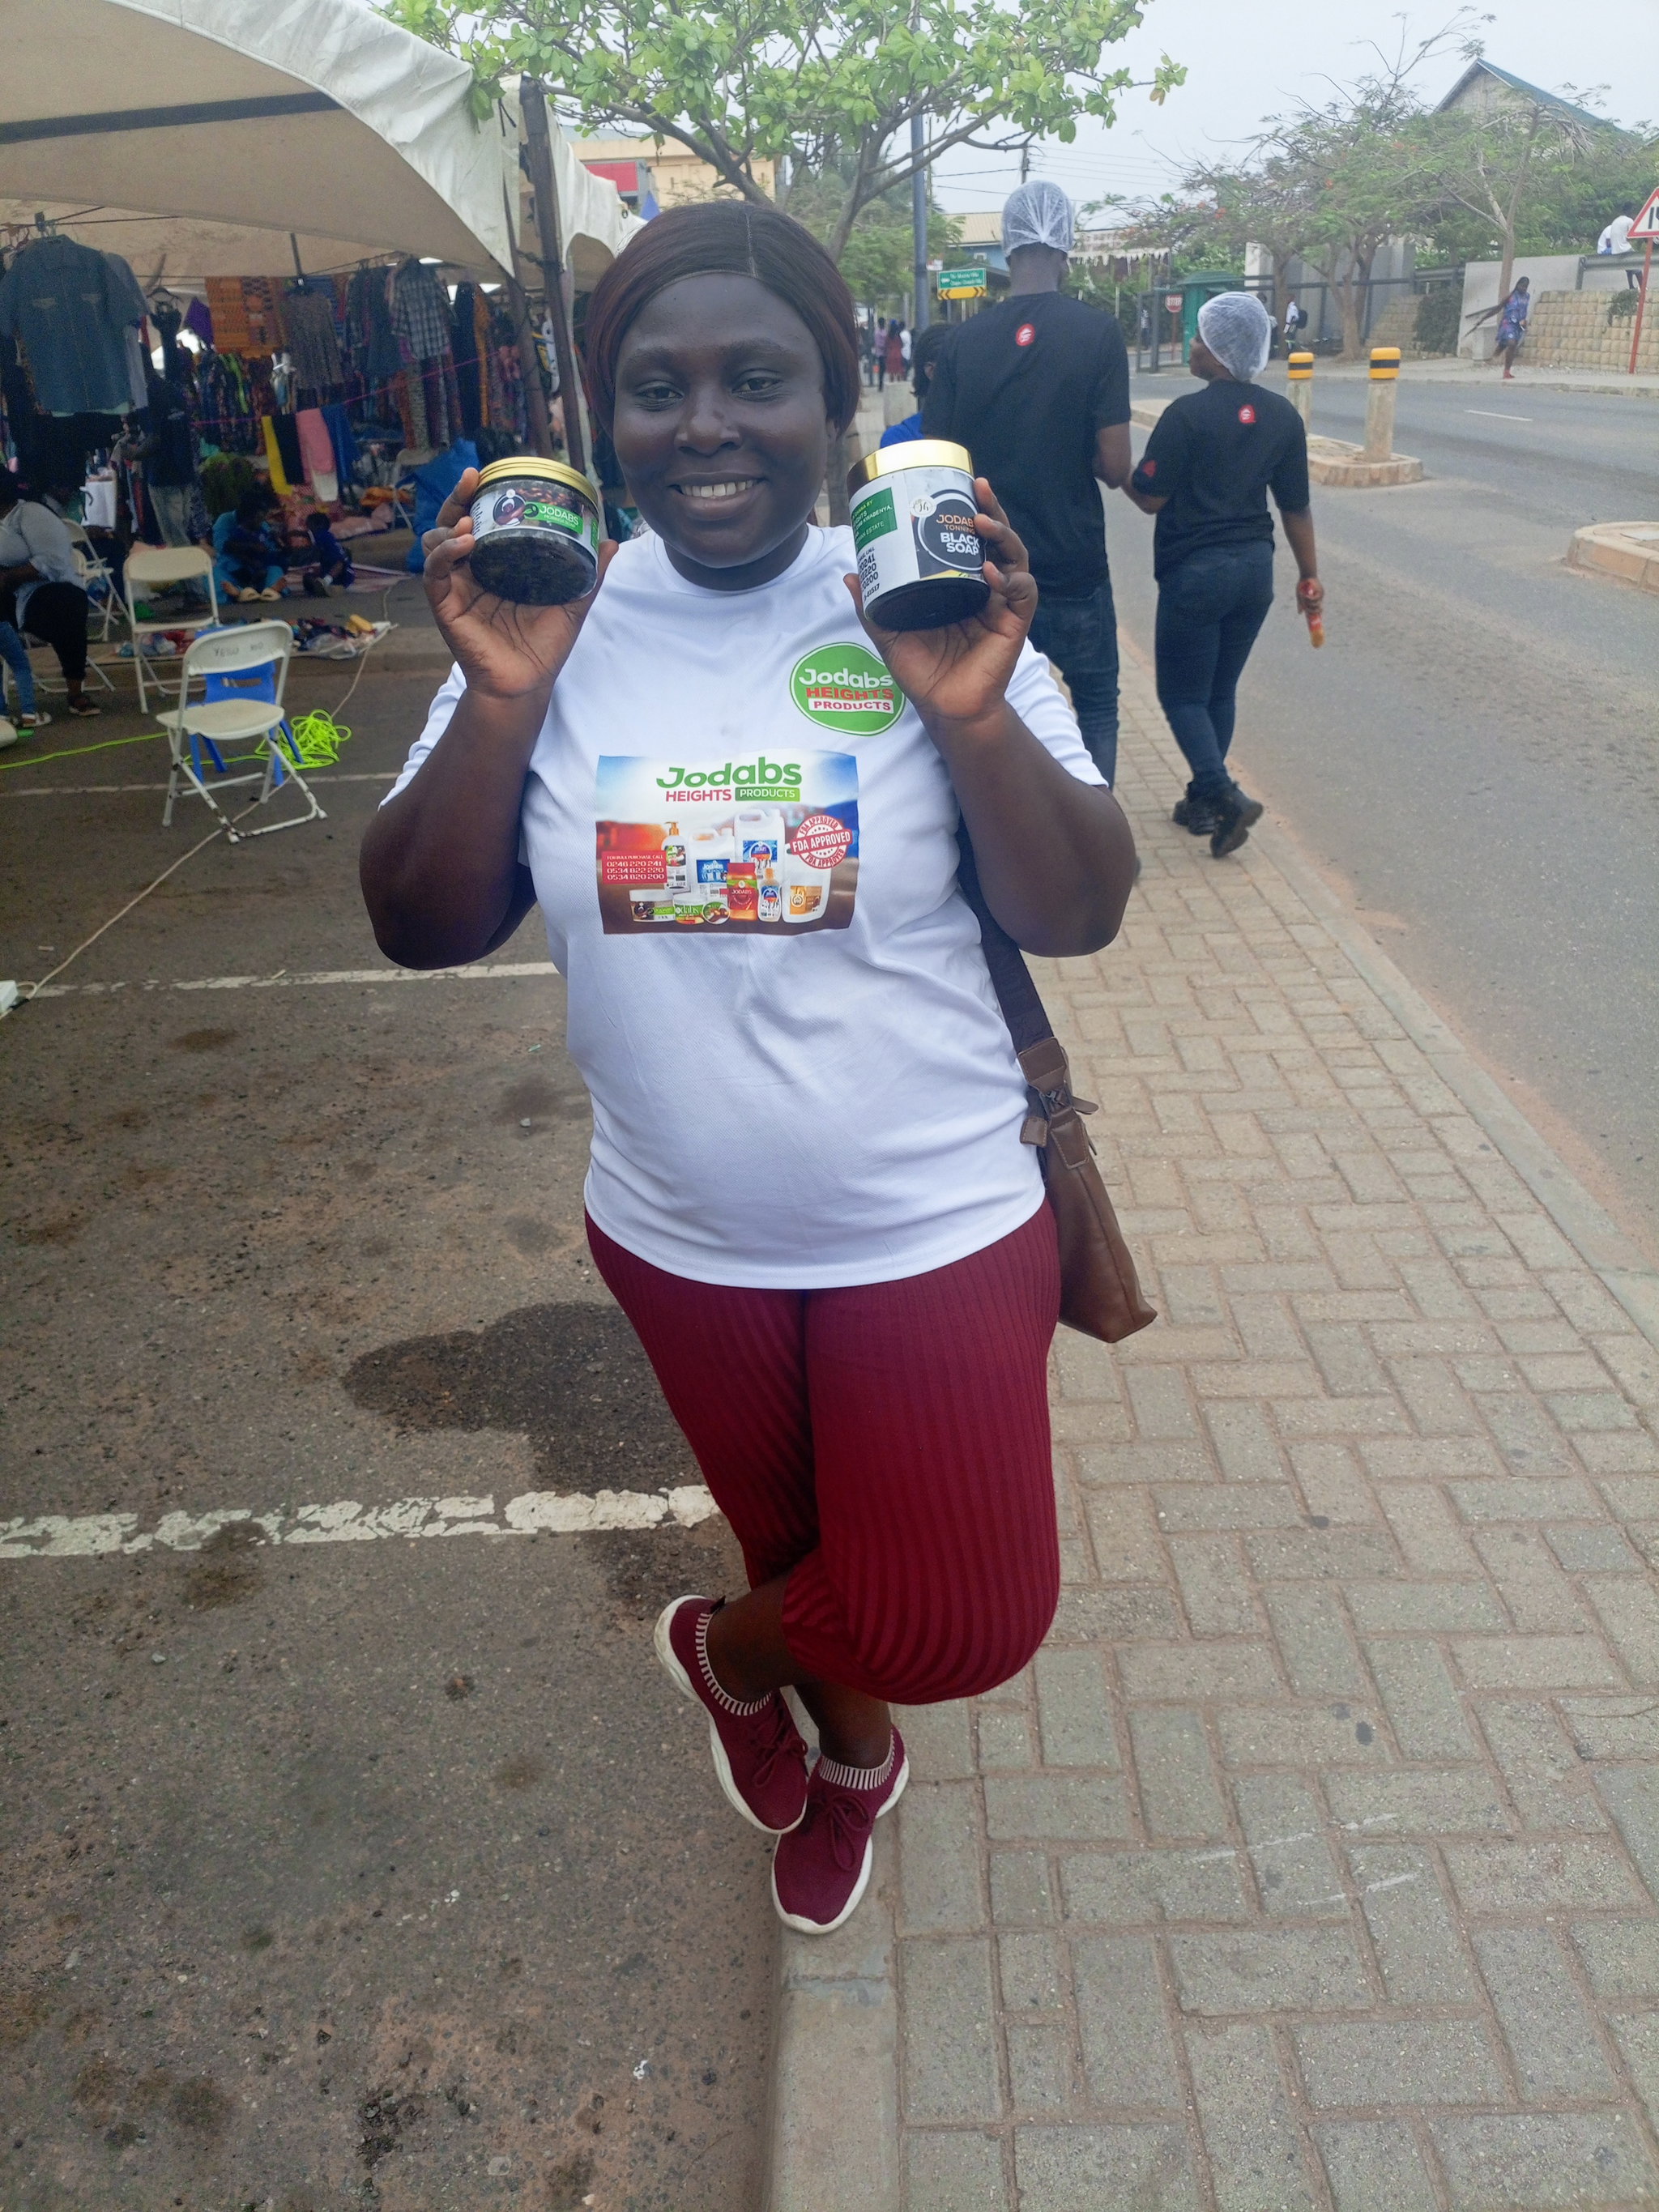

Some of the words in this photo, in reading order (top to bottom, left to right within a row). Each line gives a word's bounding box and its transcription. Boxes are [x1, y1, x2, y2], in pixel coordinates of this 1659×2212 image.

[539, 505, 579, 526] JODABS
[936, 514, 974, 527] JODAB
[940, 532, 980, 548] BLACK
[946, 542, 979, 556] SOAP
[799, 667, 893, 688] Jodabs
[806, 687, 894, 700] HEIGHTS
[813, 701, 891, 710] PRODUCTS
[656, 757, 802, 788] Jodabs
[666, 789, 731, 802] HEIGHTS
[740, 789, 795, 798] PRODUCTS
[809, 816, 838, 829] APPROVED
[792, 840, 809, 853] FDA
[810, 831, 851, 849] APPROVED
[805, 855, 817, 865] FDA
[817, 848, 844, 867] APPROVED
